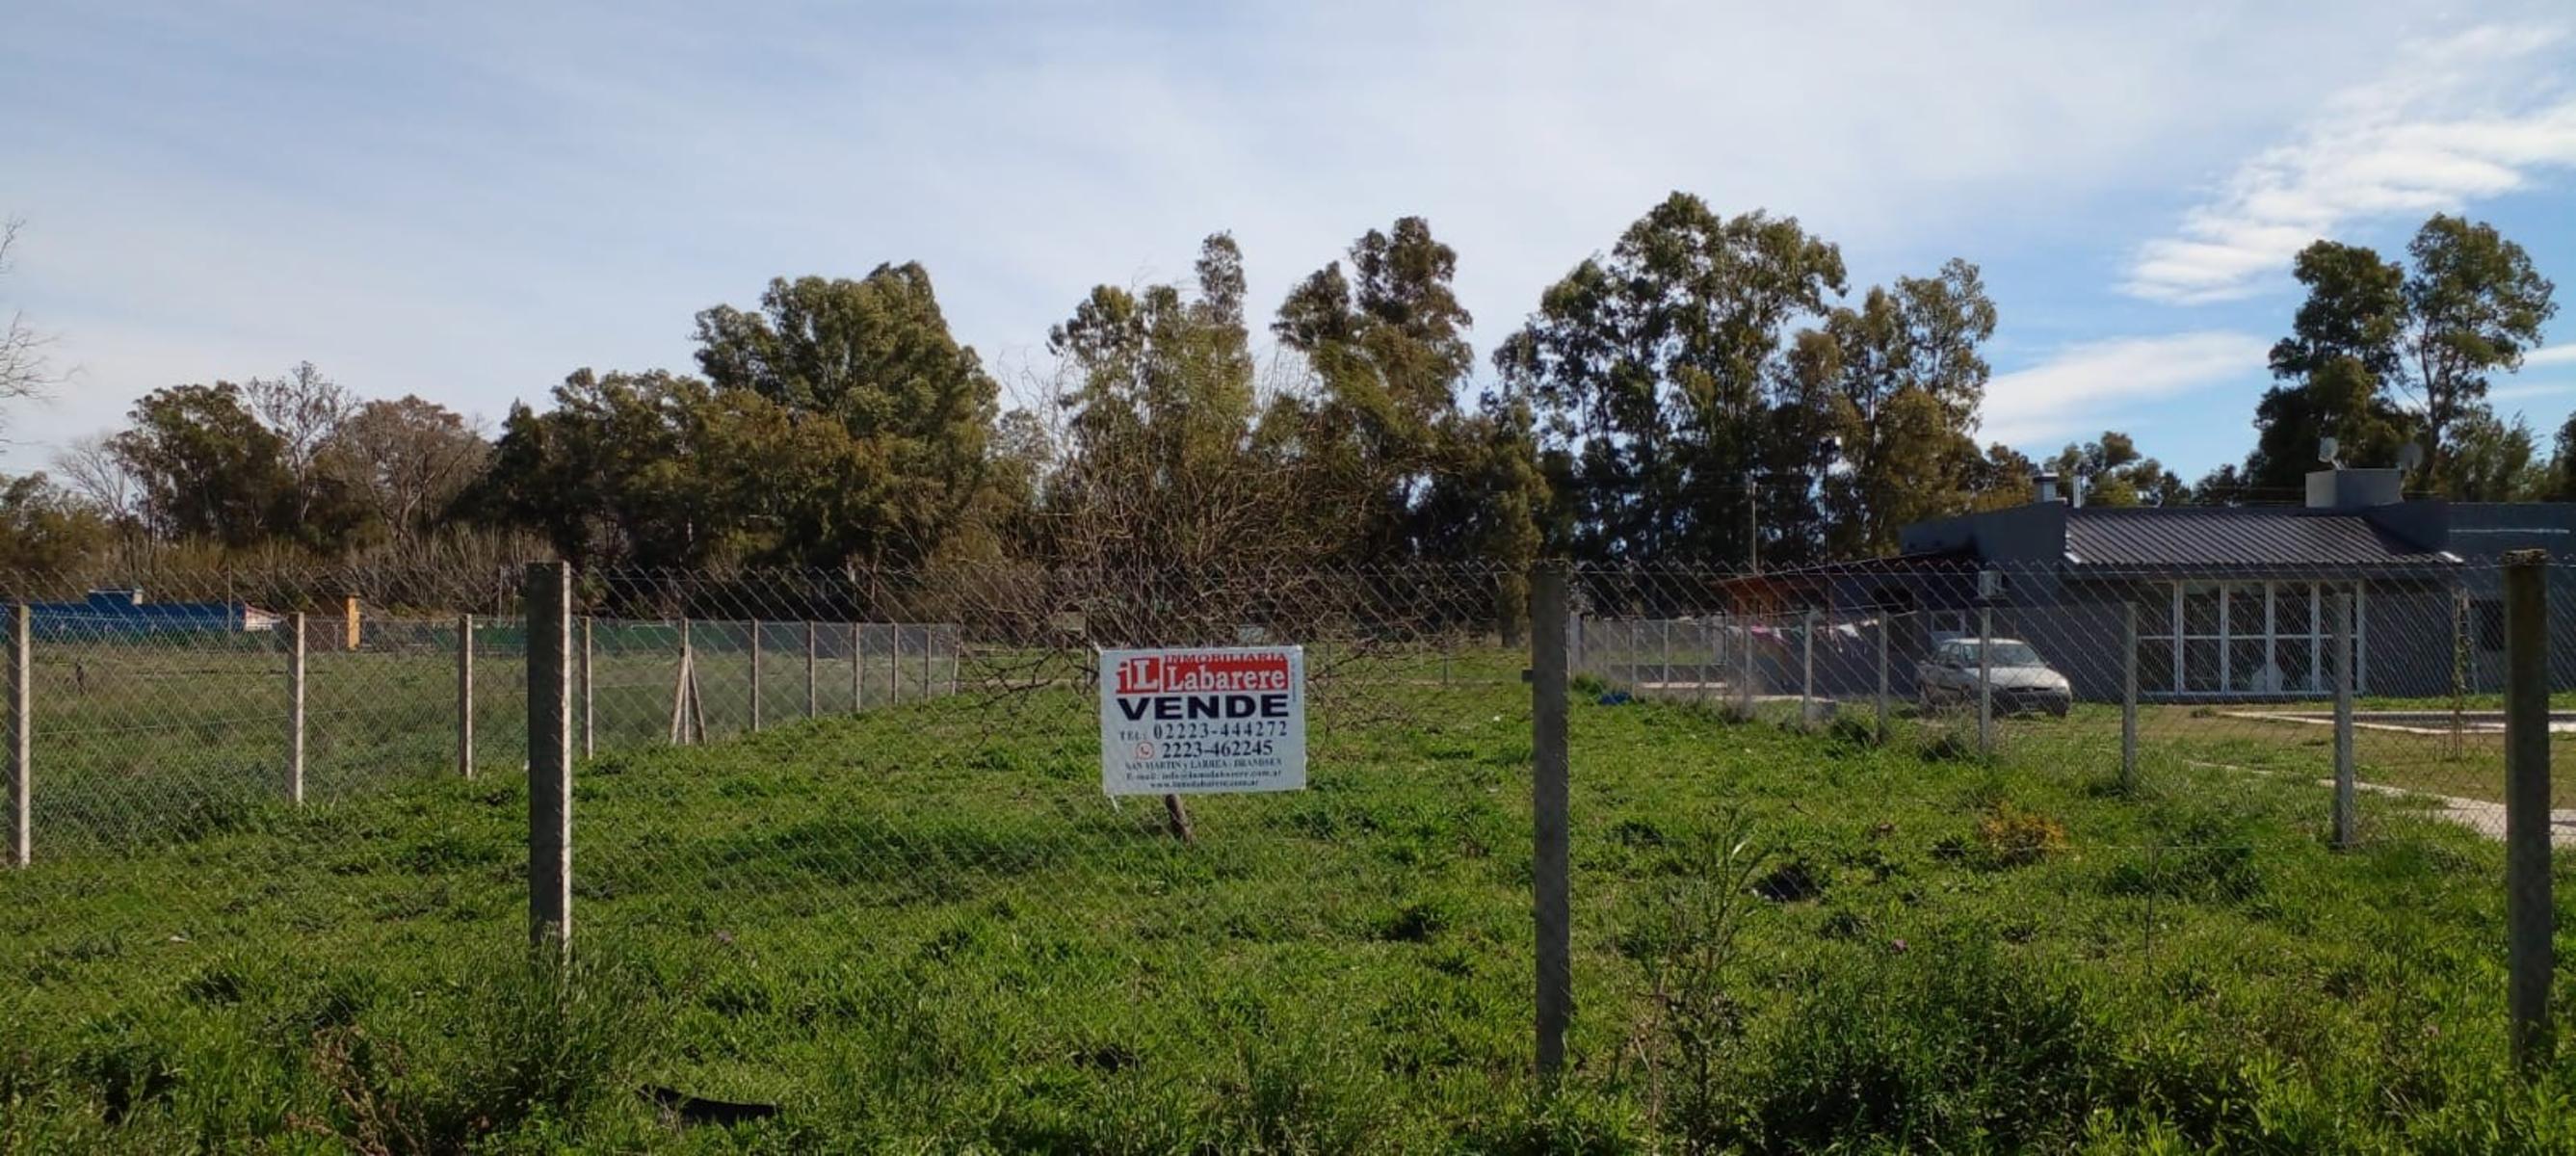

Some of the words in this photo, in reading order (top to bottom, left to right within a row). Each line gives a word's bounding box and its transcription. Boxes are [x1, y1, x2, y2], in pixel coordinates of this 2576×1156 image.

[1165, 652, 1286, 665] INMOBILIARIA
[1167, 665, 1285, 692] Labarere
[1117, 695, 1289, 721] VENDE
[1153, 721, 1288, 740] 02223-444272
[1162, 739, 1274, 759] 2223-462245
[1145, 759, 1181, 771] MARTIN
